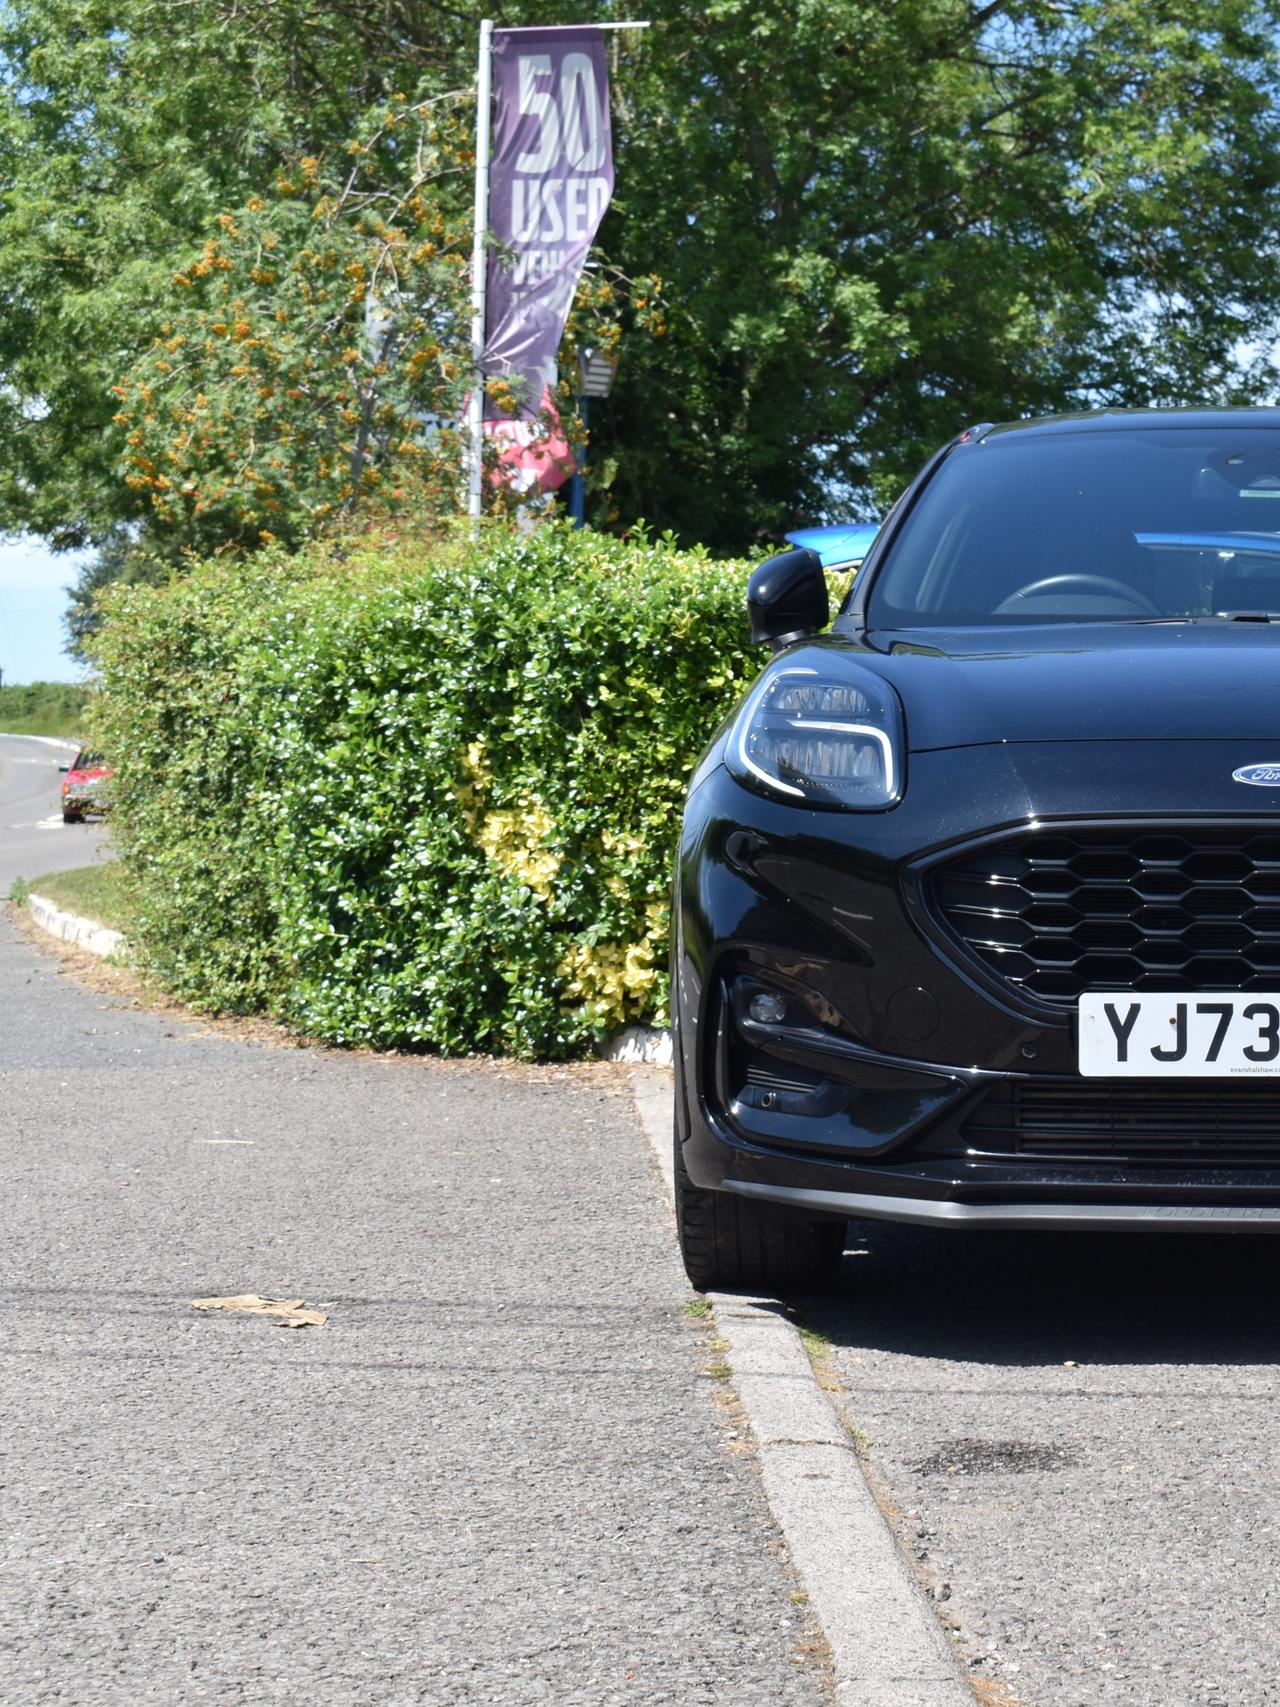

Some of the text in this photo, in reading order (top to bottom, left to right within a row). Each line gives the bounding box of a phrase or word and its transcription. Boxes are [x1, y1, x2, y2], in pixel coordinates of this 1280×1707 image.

[515, 52, 606, 174] 50
[511, 177, 611, 243] USED
[1103, 1002, 1280, 1063] YJ73
